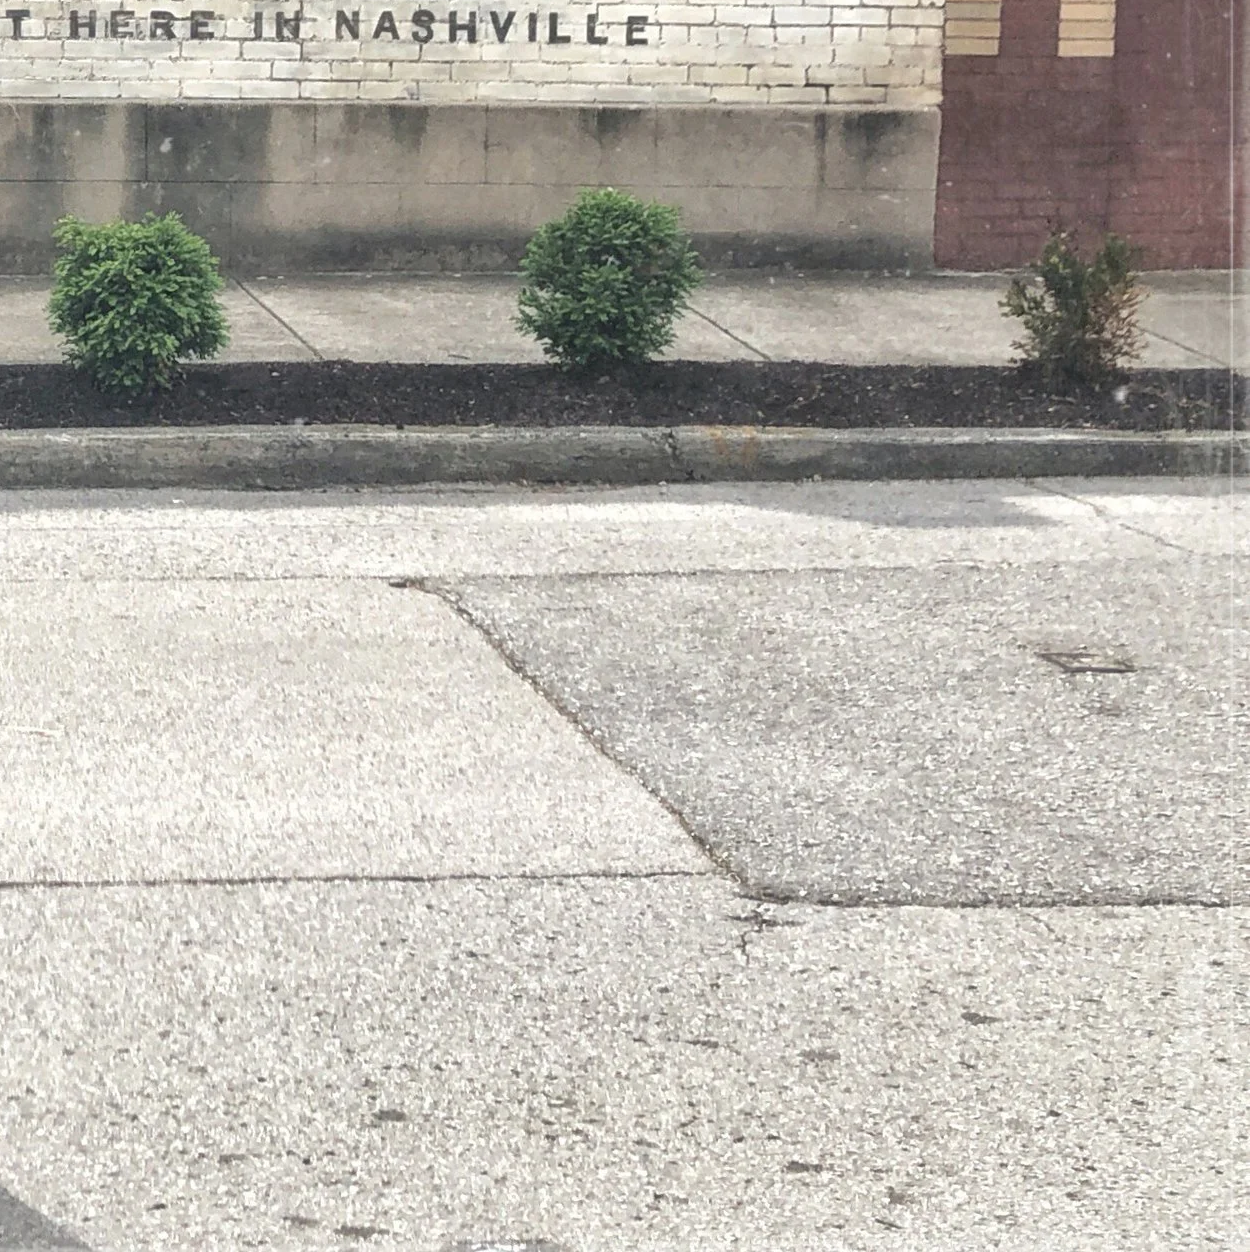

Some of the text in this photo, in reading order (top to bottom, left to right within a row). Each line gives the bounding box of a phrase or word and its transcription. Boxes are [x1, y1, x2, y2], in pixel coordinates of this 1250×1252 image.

[69, 9, 217, 40] HERE
[253, 9, 301, 41] IN
[335, 9, 649, 46] NASHVILLE
